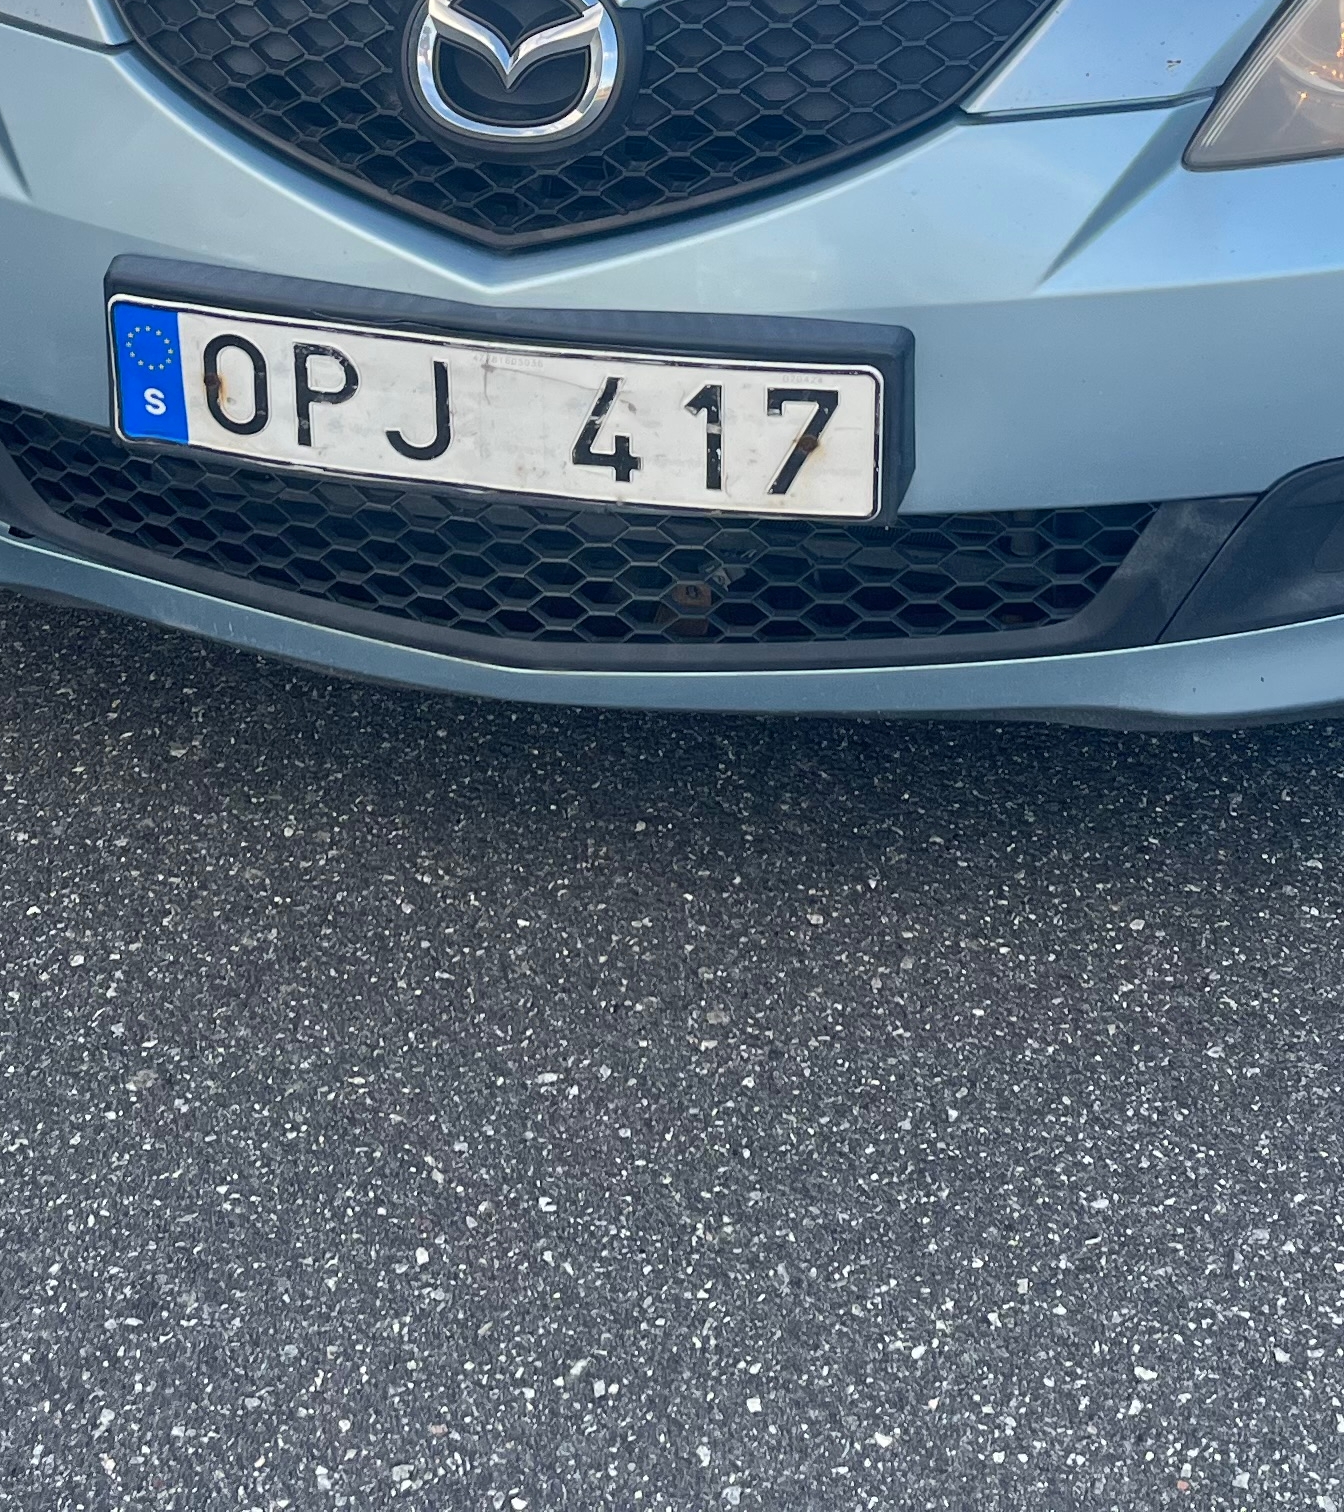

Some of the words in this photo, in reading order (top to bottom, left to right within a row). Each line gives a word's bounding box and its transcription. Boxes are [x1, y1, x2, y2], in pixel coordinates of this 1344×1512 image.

[144, 386, 167, 416] S
[202, 333, 453, 461] OPJ
[571, 375, 841, 496] 417
